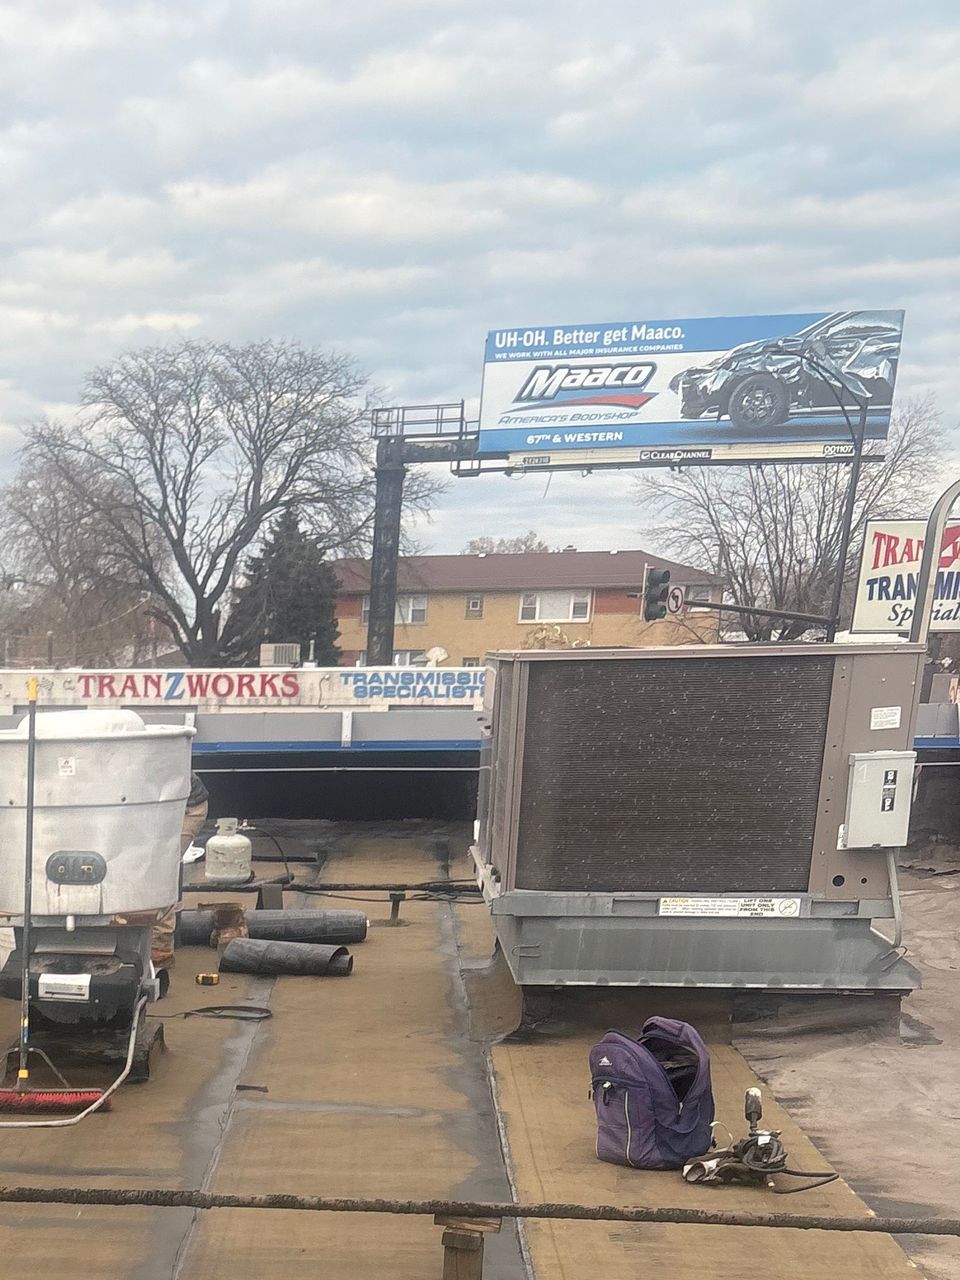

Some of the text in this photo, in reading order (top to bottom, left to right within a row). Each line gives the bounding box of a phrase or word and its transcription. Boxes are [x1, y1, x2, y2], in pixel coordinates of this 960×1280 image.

[495, 325, 685, 348] UH-OH. Better get Maaco.
[495, 352, 507, 360] WE
[509, 351, 531, 359] WORK
[532, 350, 553, 358] WITH
[569, 347, 594, 356] MAJOR
[595, 345, 638, 355] INSURANCE
[639, 343, 684, 352] COMPANIES
[516, 363, 656, 402] Maaco
[552, 433, 562, 443] &
[564, 431, 623, 443] WESTERN
[78, 671, 300, 701] TRANZWORKS
